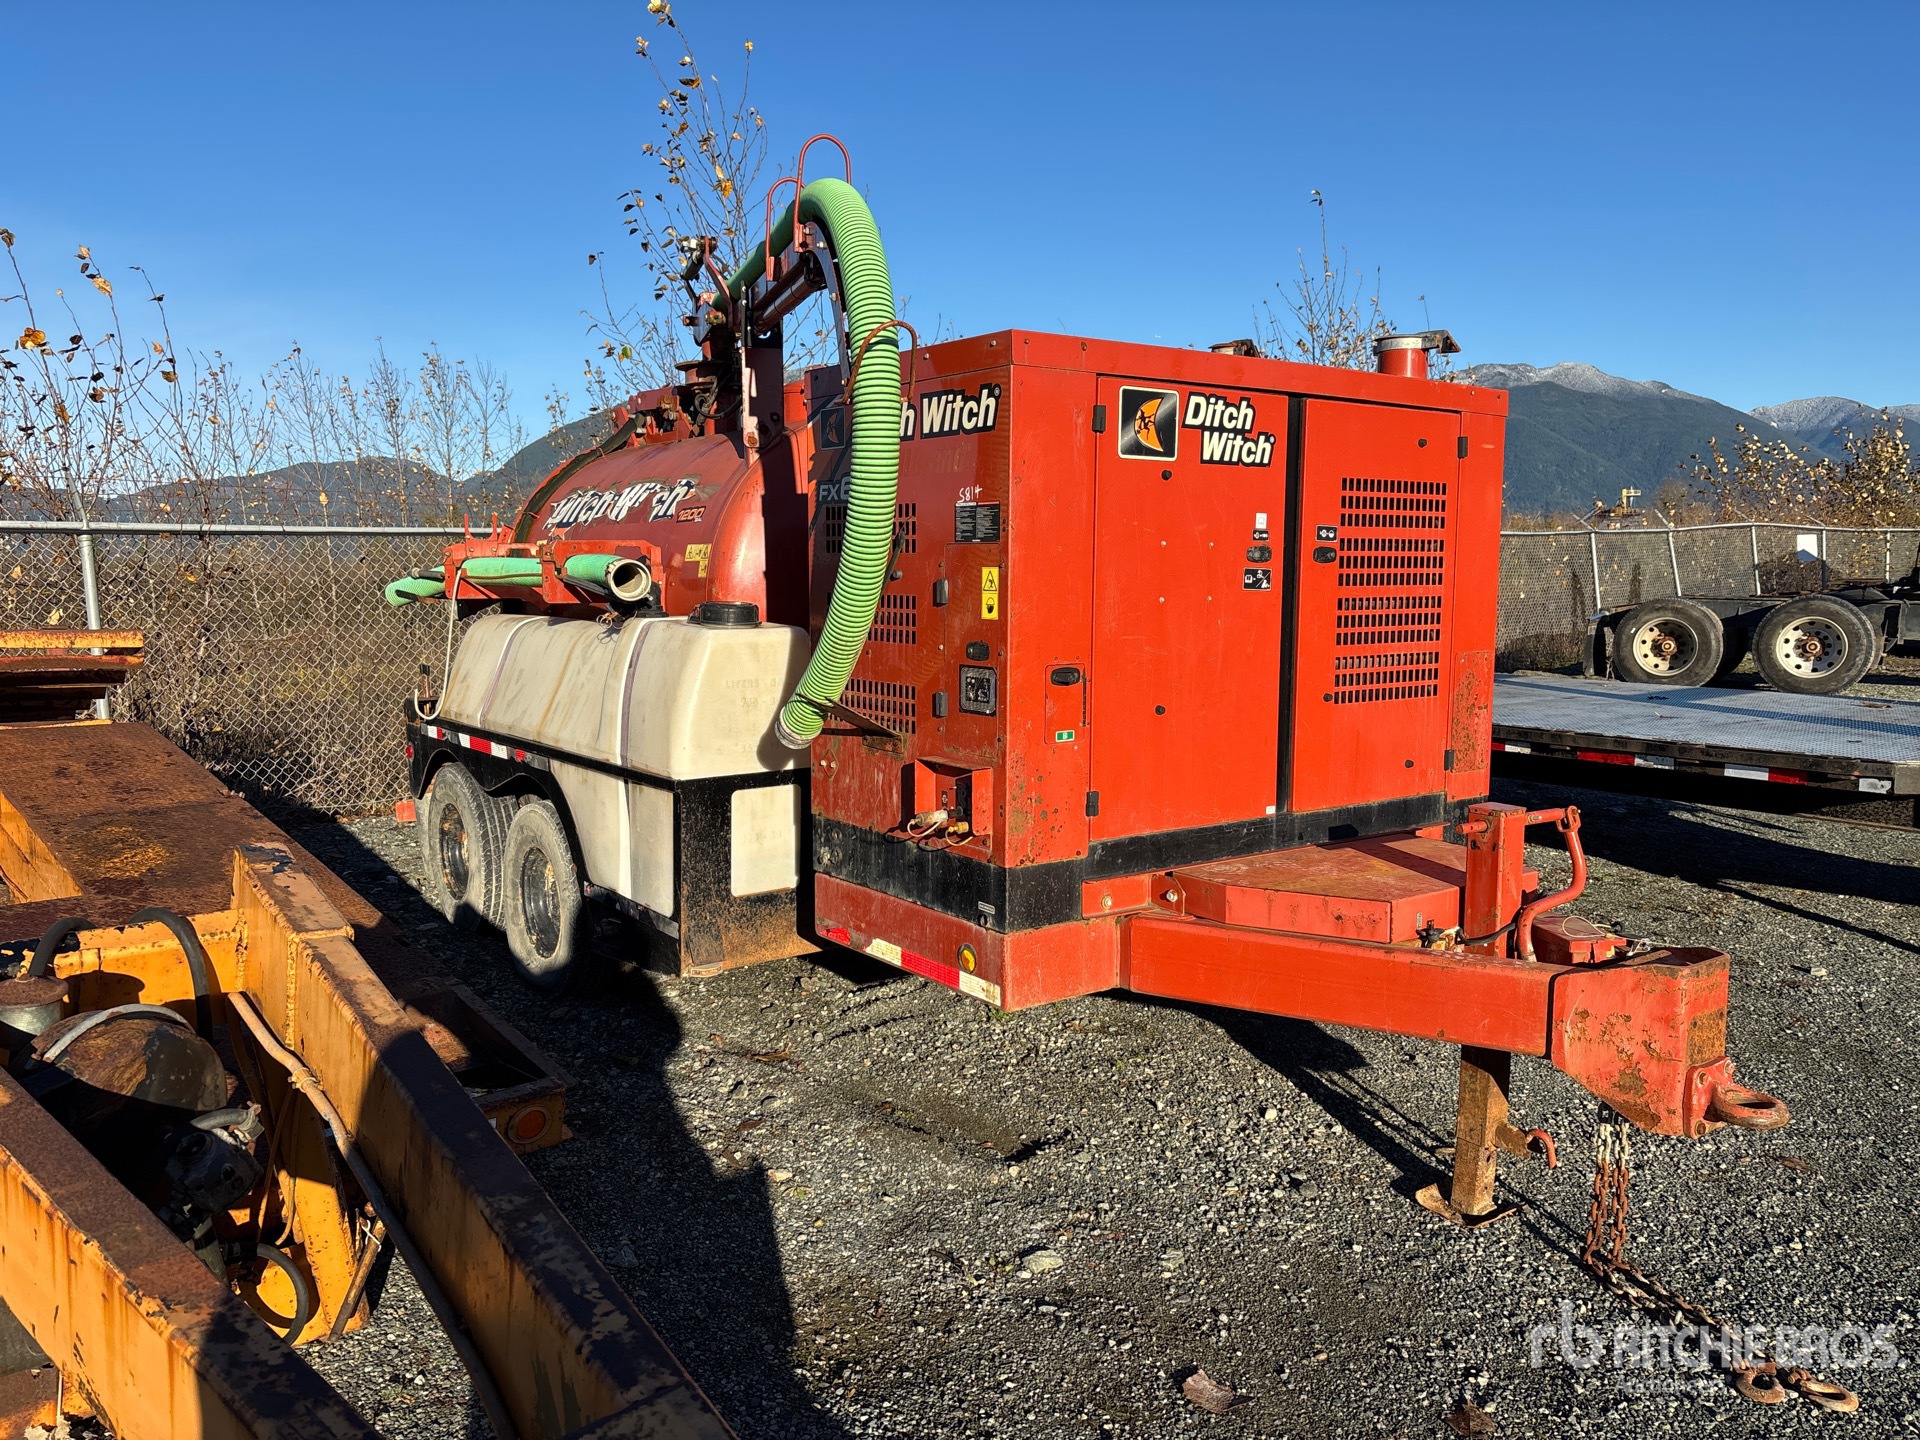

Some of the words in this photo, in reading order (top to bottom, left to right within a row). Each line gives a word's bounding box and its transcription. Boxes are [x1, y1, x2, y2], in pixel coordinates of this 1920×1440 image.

[922, 388, 996, 434] Witch
[1184, 395, 1254, 430] Ditch
[1202, 431, 1272, 464] Witch
[819, 475, 851, 501] FX6
[678, 507, 705, 521] 1200
